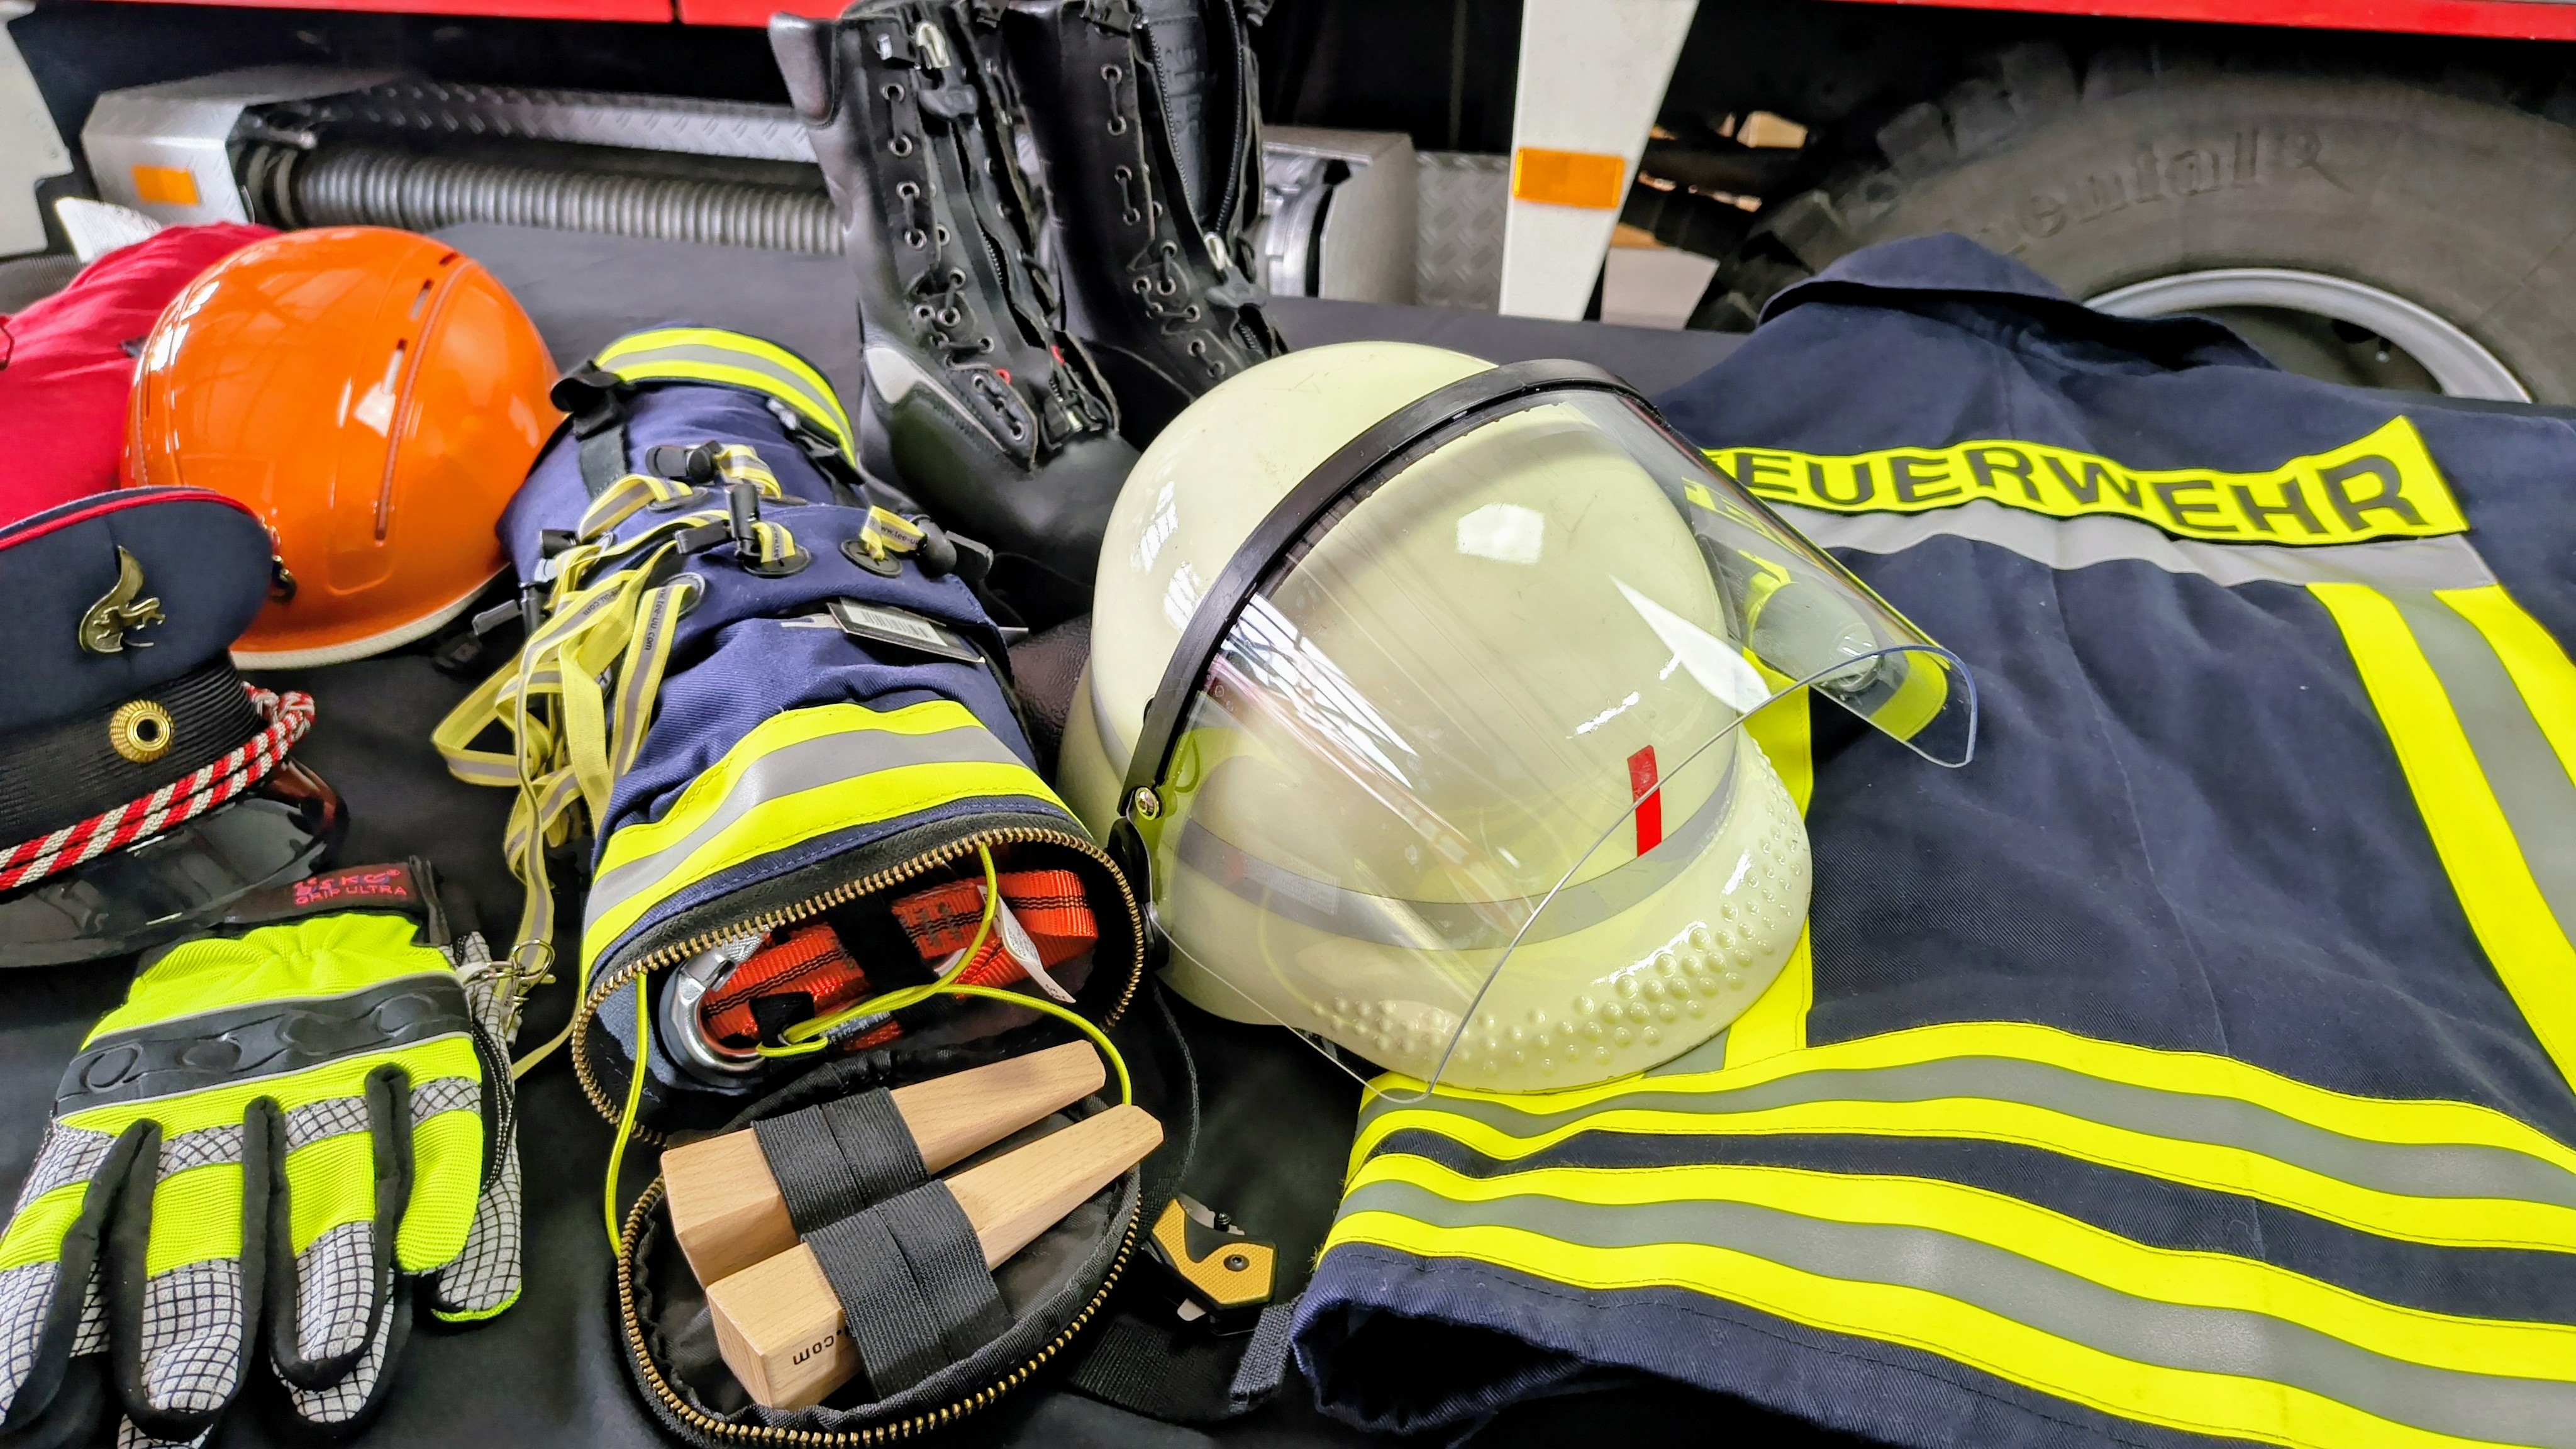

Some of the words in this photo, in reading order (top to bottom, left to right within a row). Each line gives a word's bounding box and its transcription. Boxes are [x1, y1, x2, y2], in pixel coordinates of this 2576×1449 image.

[1709, 447, 2429, 533] EUERWEHR
[295, 888, 341, 906] GRIP
[346, 884, 408, 896] ULTRA
